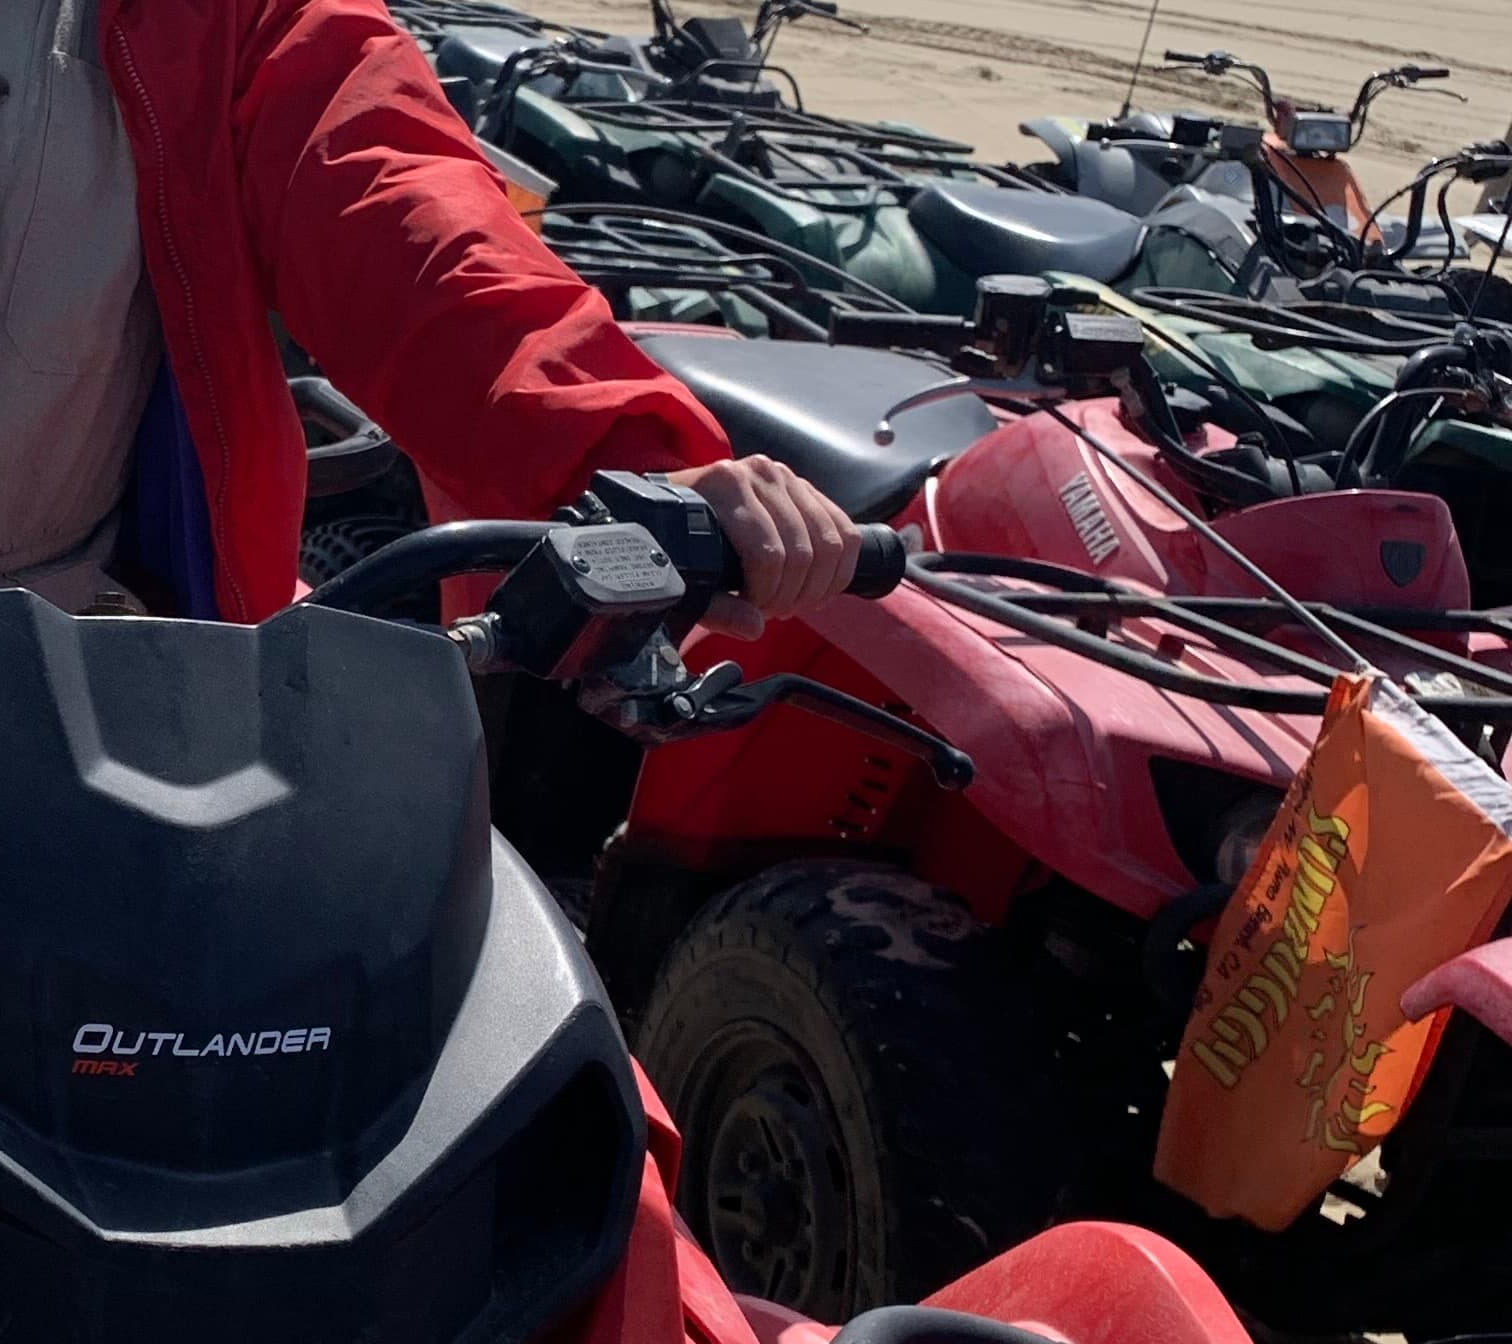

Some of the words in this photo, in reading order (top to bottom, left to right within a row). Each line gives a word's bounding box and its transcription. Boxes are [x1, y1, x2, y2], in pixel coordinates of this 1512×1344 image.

[1059, 470, 1120, 565] YAMAHA
[72, 1023, 332, 1057] OUTLANDER
[71, 1059, 139, 1077] MAX
